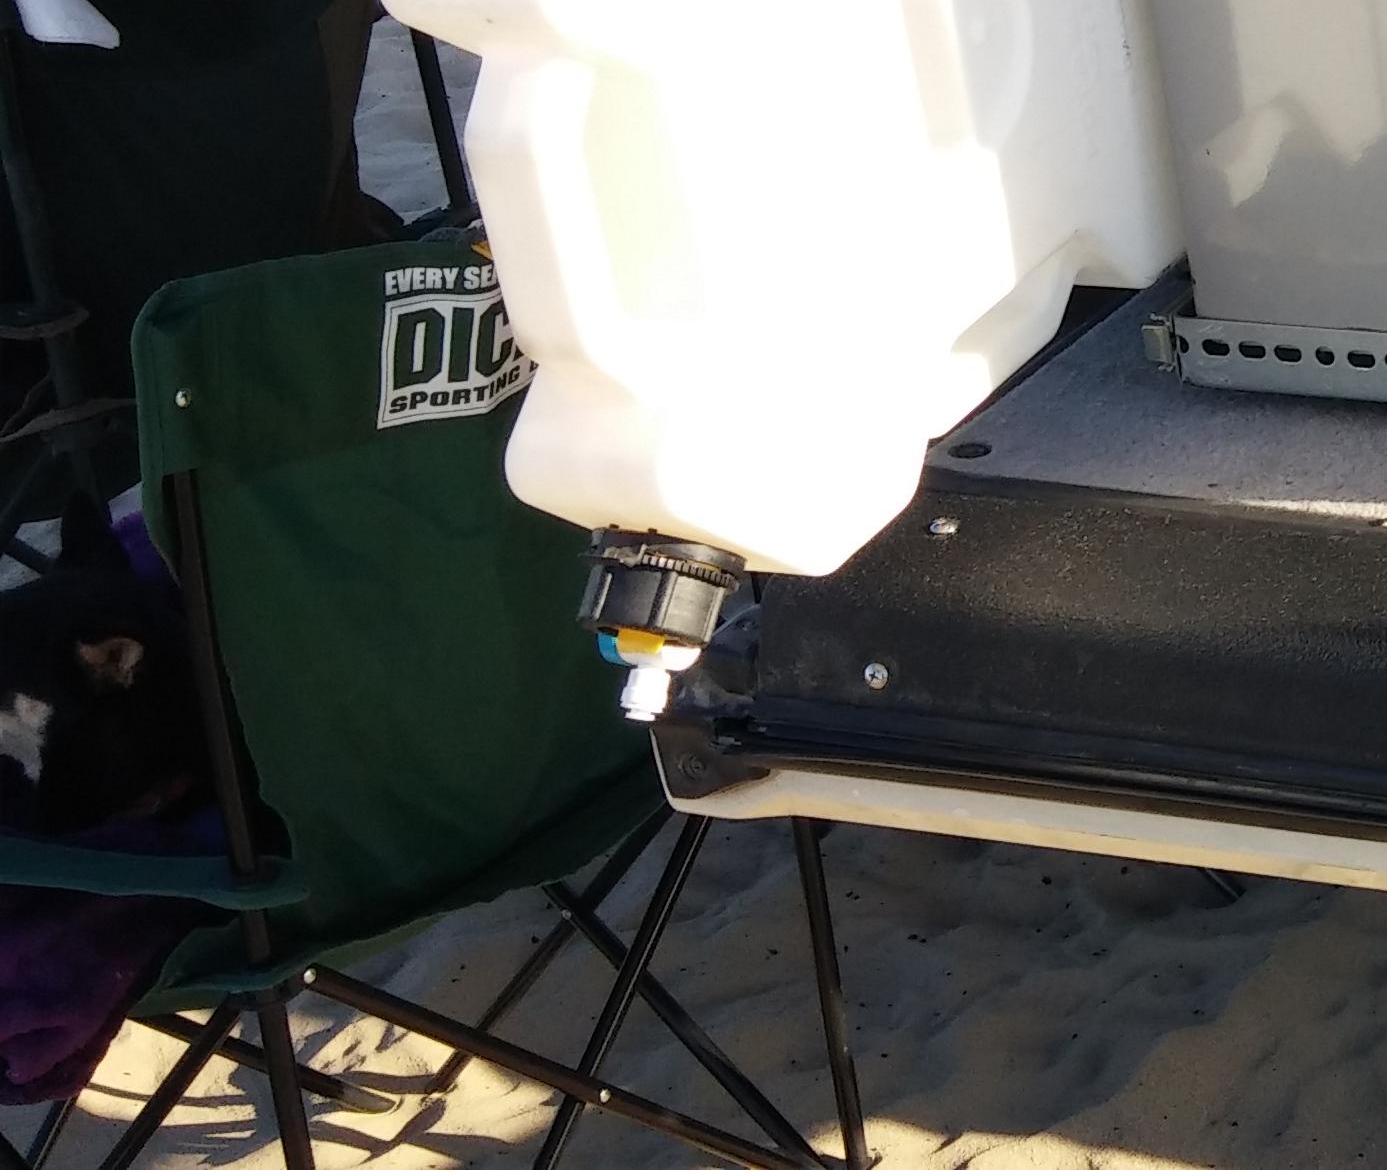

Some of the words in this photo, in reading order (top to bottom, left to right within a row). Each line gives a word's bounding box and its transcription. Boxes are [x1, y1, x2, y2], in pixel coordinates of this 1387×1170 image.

[385, 267, 460, 296] EVERY
[464, 265, 499, 289] SE
[394, 300, 525, 390] DIC
[389, 365, 521, 414] SPORTING
